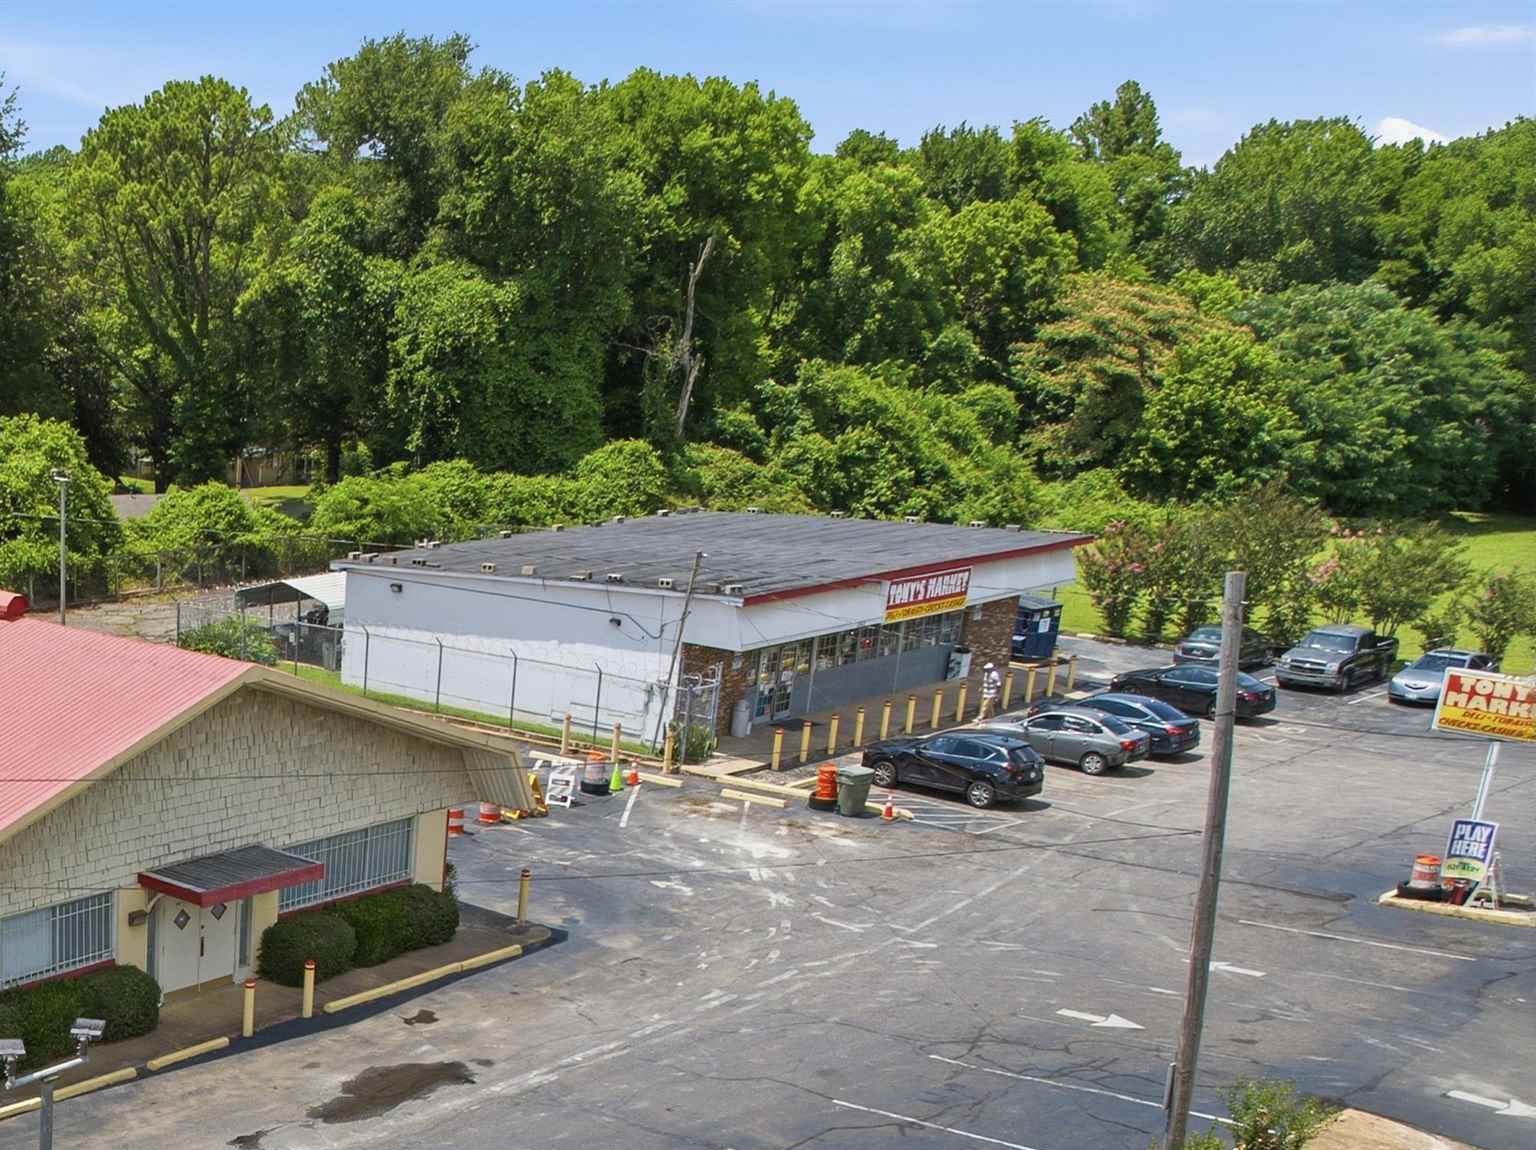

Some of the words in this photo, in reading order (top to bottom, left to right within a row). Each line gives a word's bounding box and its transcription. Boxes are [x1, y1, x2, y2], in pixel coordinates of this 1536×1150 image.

[1460, 676, 1536, 702] TONY
[1454, 824, 1492, 843] PLAY
[1450, 840, 1488, 859] HERE
